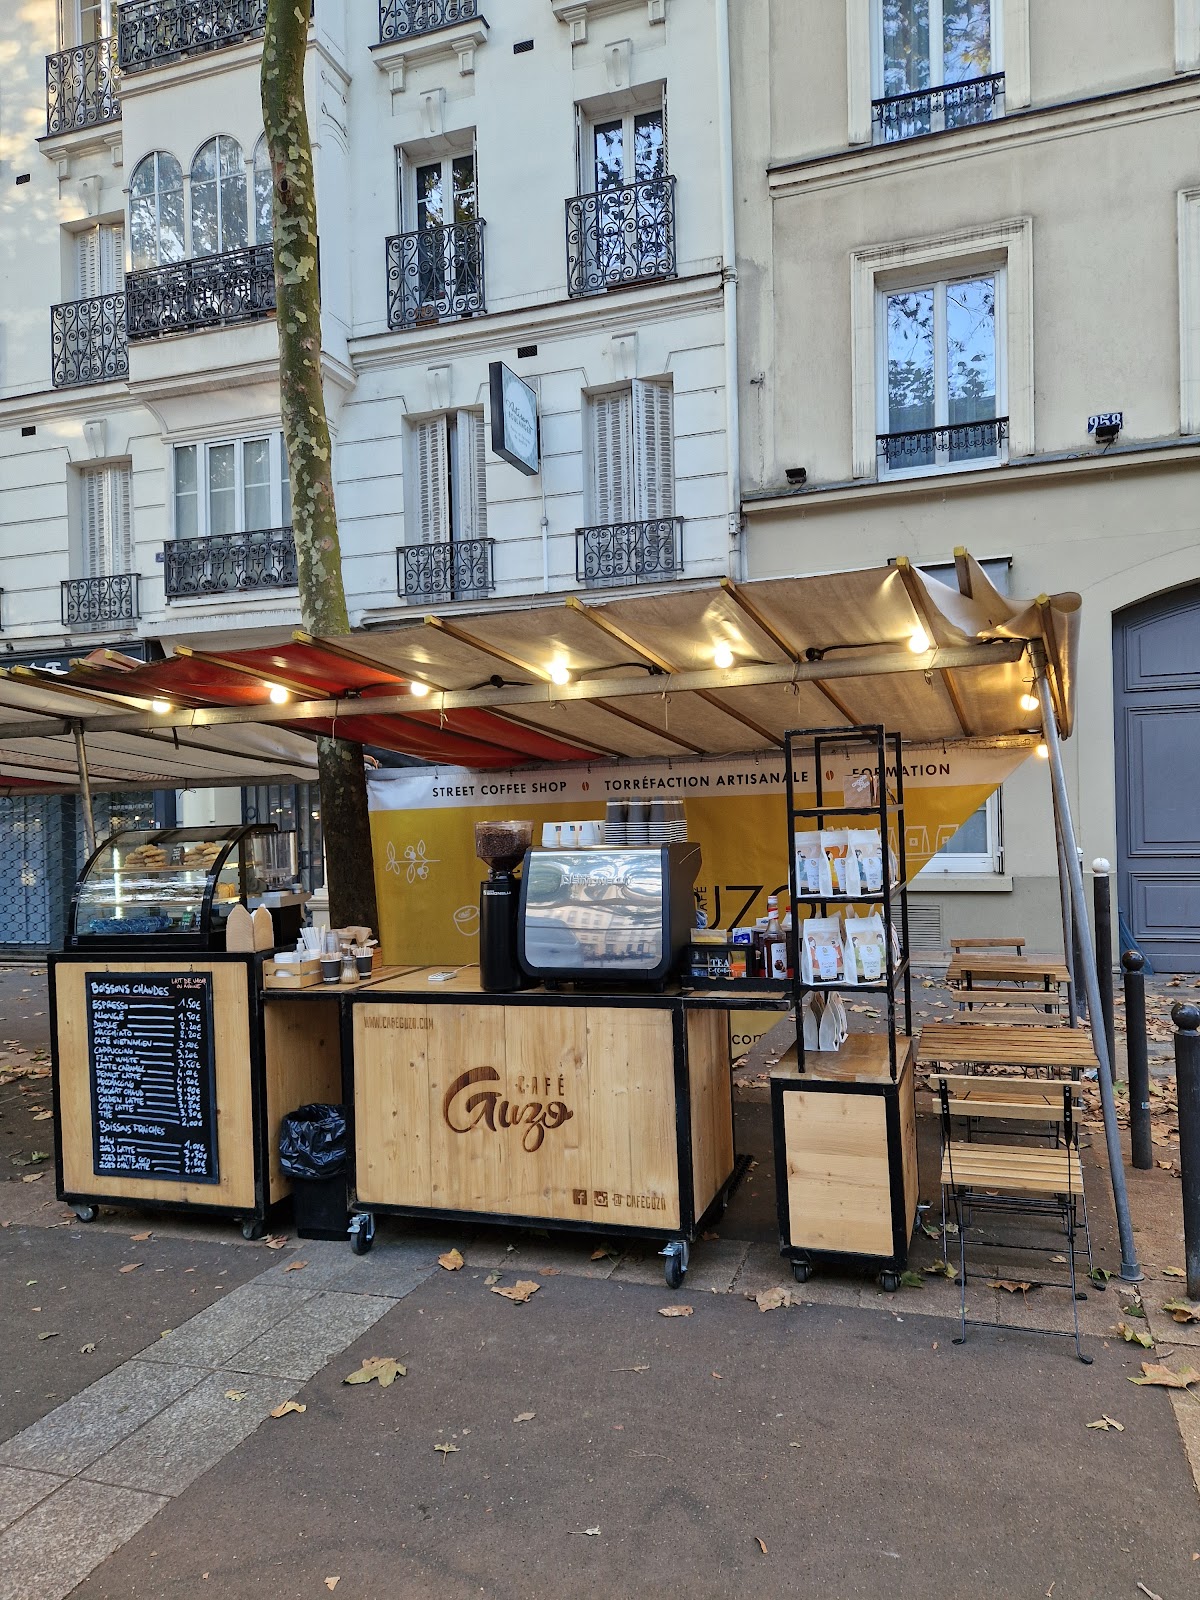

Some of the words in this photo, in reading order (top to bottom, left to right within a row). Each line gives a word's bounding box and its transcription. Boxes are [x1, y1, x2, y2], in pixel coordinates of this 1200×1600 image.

[604, 774, 710, 791] TORRÉFACTION
[432, 786, 475, 797] STREET
[481, 783, 527, 795] COFFEE
[532, 781, 567, 793] SHOP
[710, 959, 729, 967] TEA
[92, 1000, 128, 1010] ESPRESSO
[96, 1062, 117, 1070] LATTE
[122, 1072, 141, 1080] LATTE
[518, 1074, 565, 1096] CAFÉ
[125, 1097, 145, 1106] LATTE
[115, 1104, 135, 1112] LATTE
[442, 1066, 574, 1152] Guzo
[117, 1146, 136, 1154] LATTE
